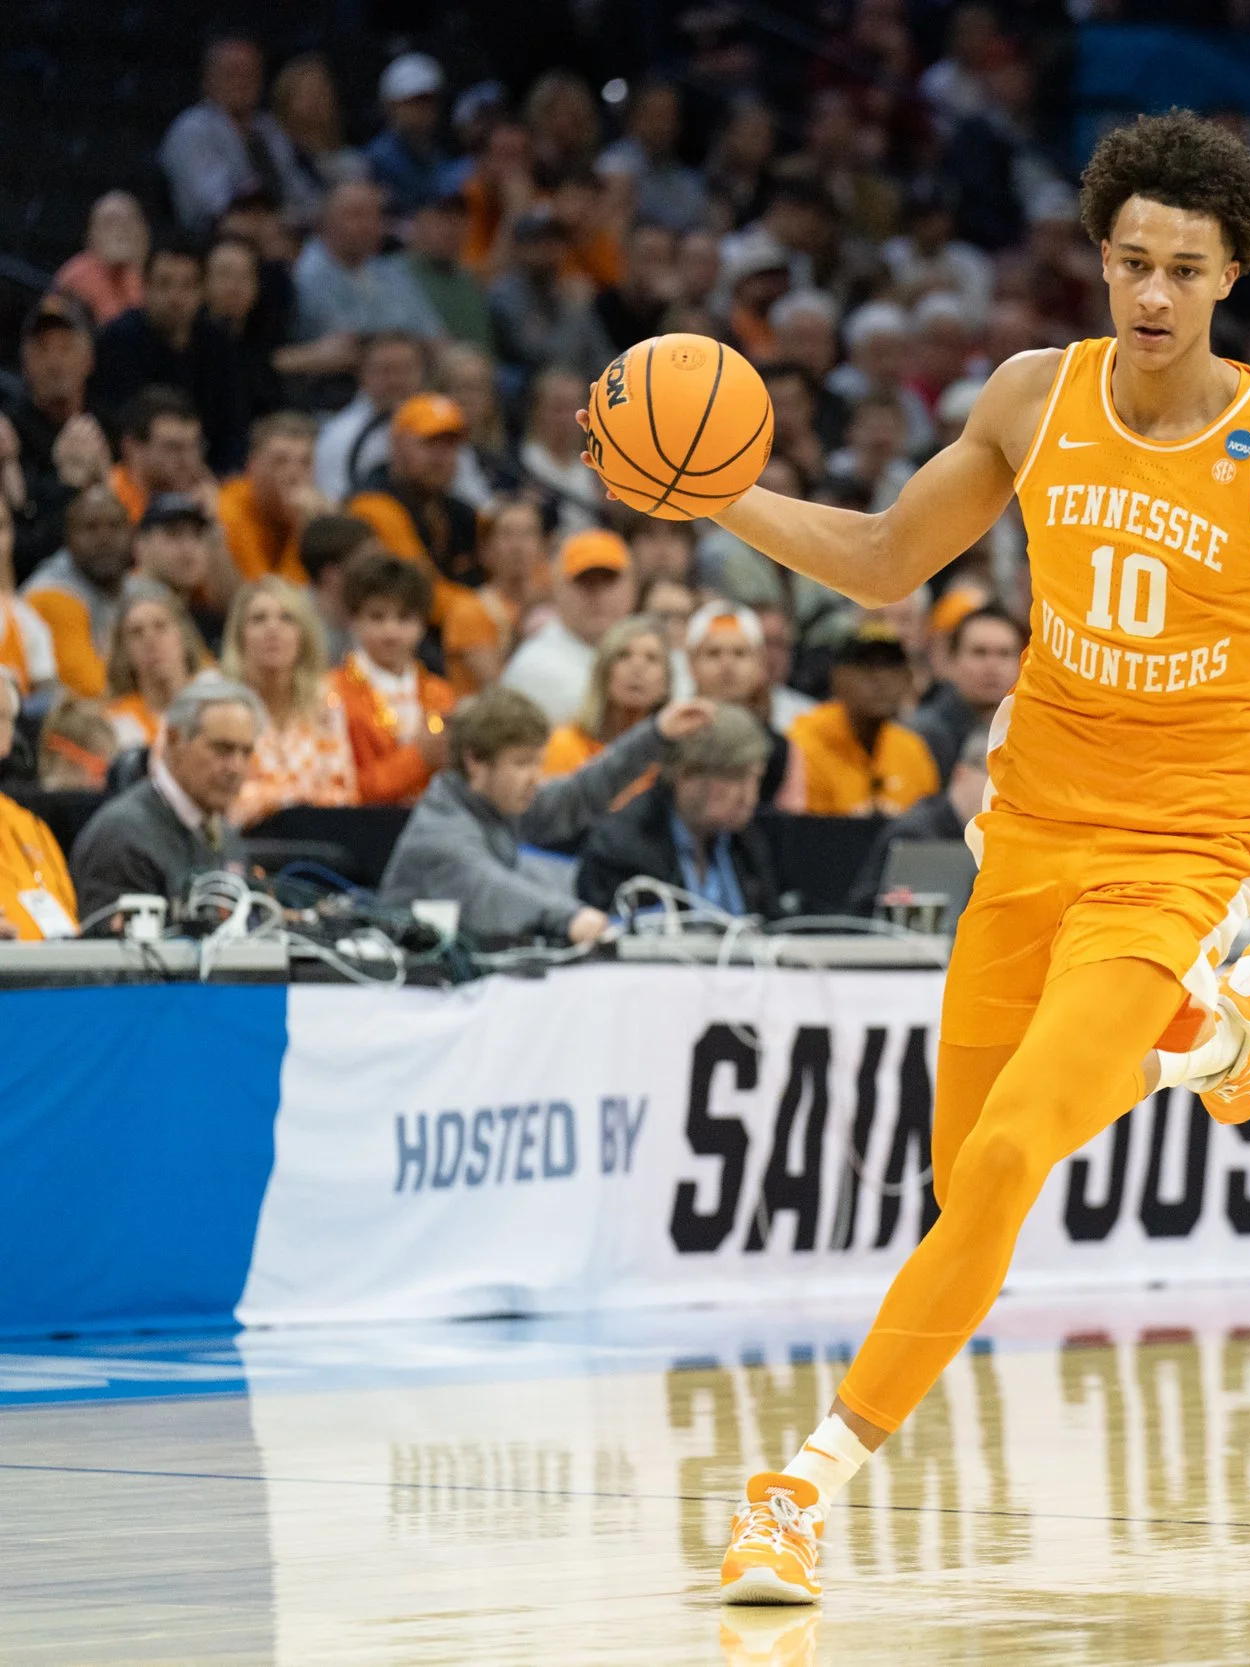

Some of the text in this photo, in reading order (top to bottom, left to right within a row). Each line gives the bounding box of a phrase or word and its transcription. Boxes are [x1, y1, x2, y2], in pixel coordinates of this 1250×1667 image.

[1214, 460, 1234, 482] SEC
[1046, 484, 1229, 573] TENNESSEE
[1086, 545, 1168, 638] 10
[1041, 599, 1231, 693] VOLUNTEERS
[394, 1099, 578, 1193] HOSTED
[597, 1095, 649, 1175] BY
[668, 1021, 943, 1255] SAIN
